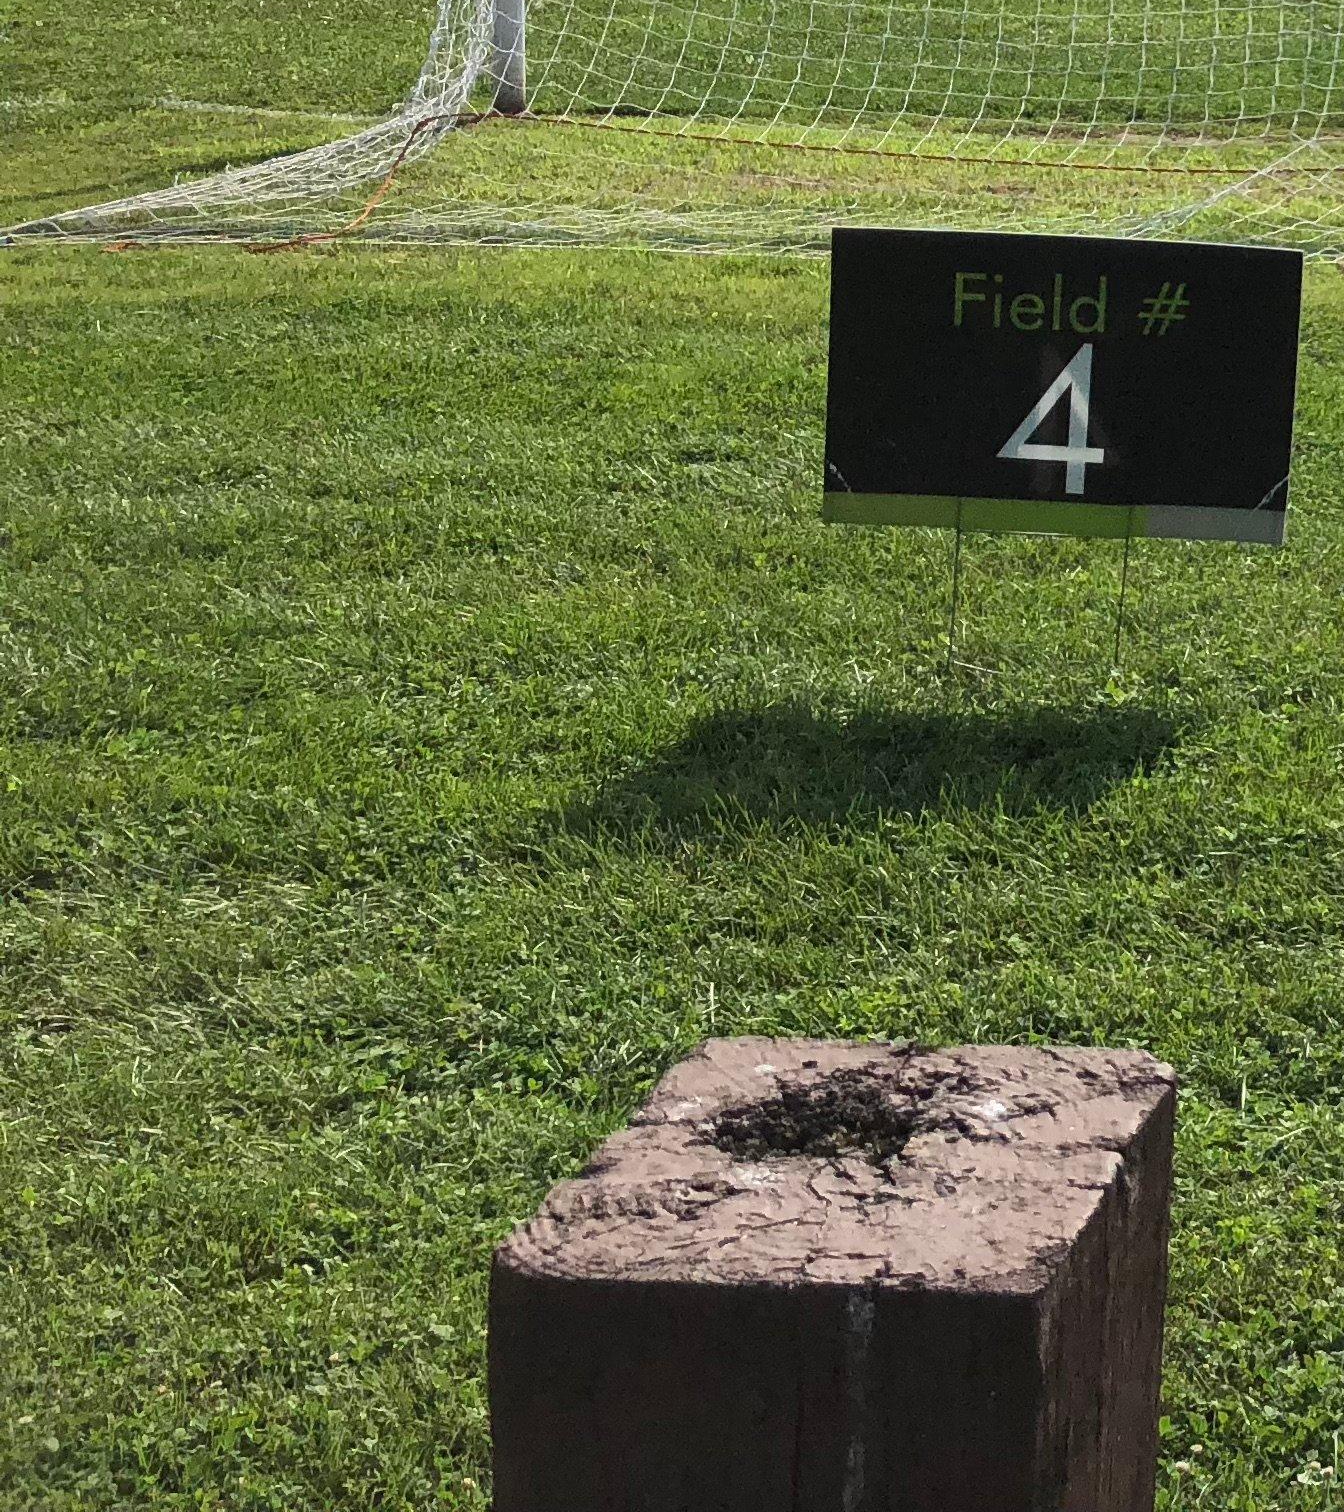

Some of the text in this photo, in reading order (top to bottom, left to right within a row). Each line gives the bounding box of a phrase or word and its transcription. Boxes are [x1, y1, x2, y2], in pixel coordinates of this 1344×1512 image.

[954, 272, 1190, 336] Field #
[996, 343, 1104, 495] 4
